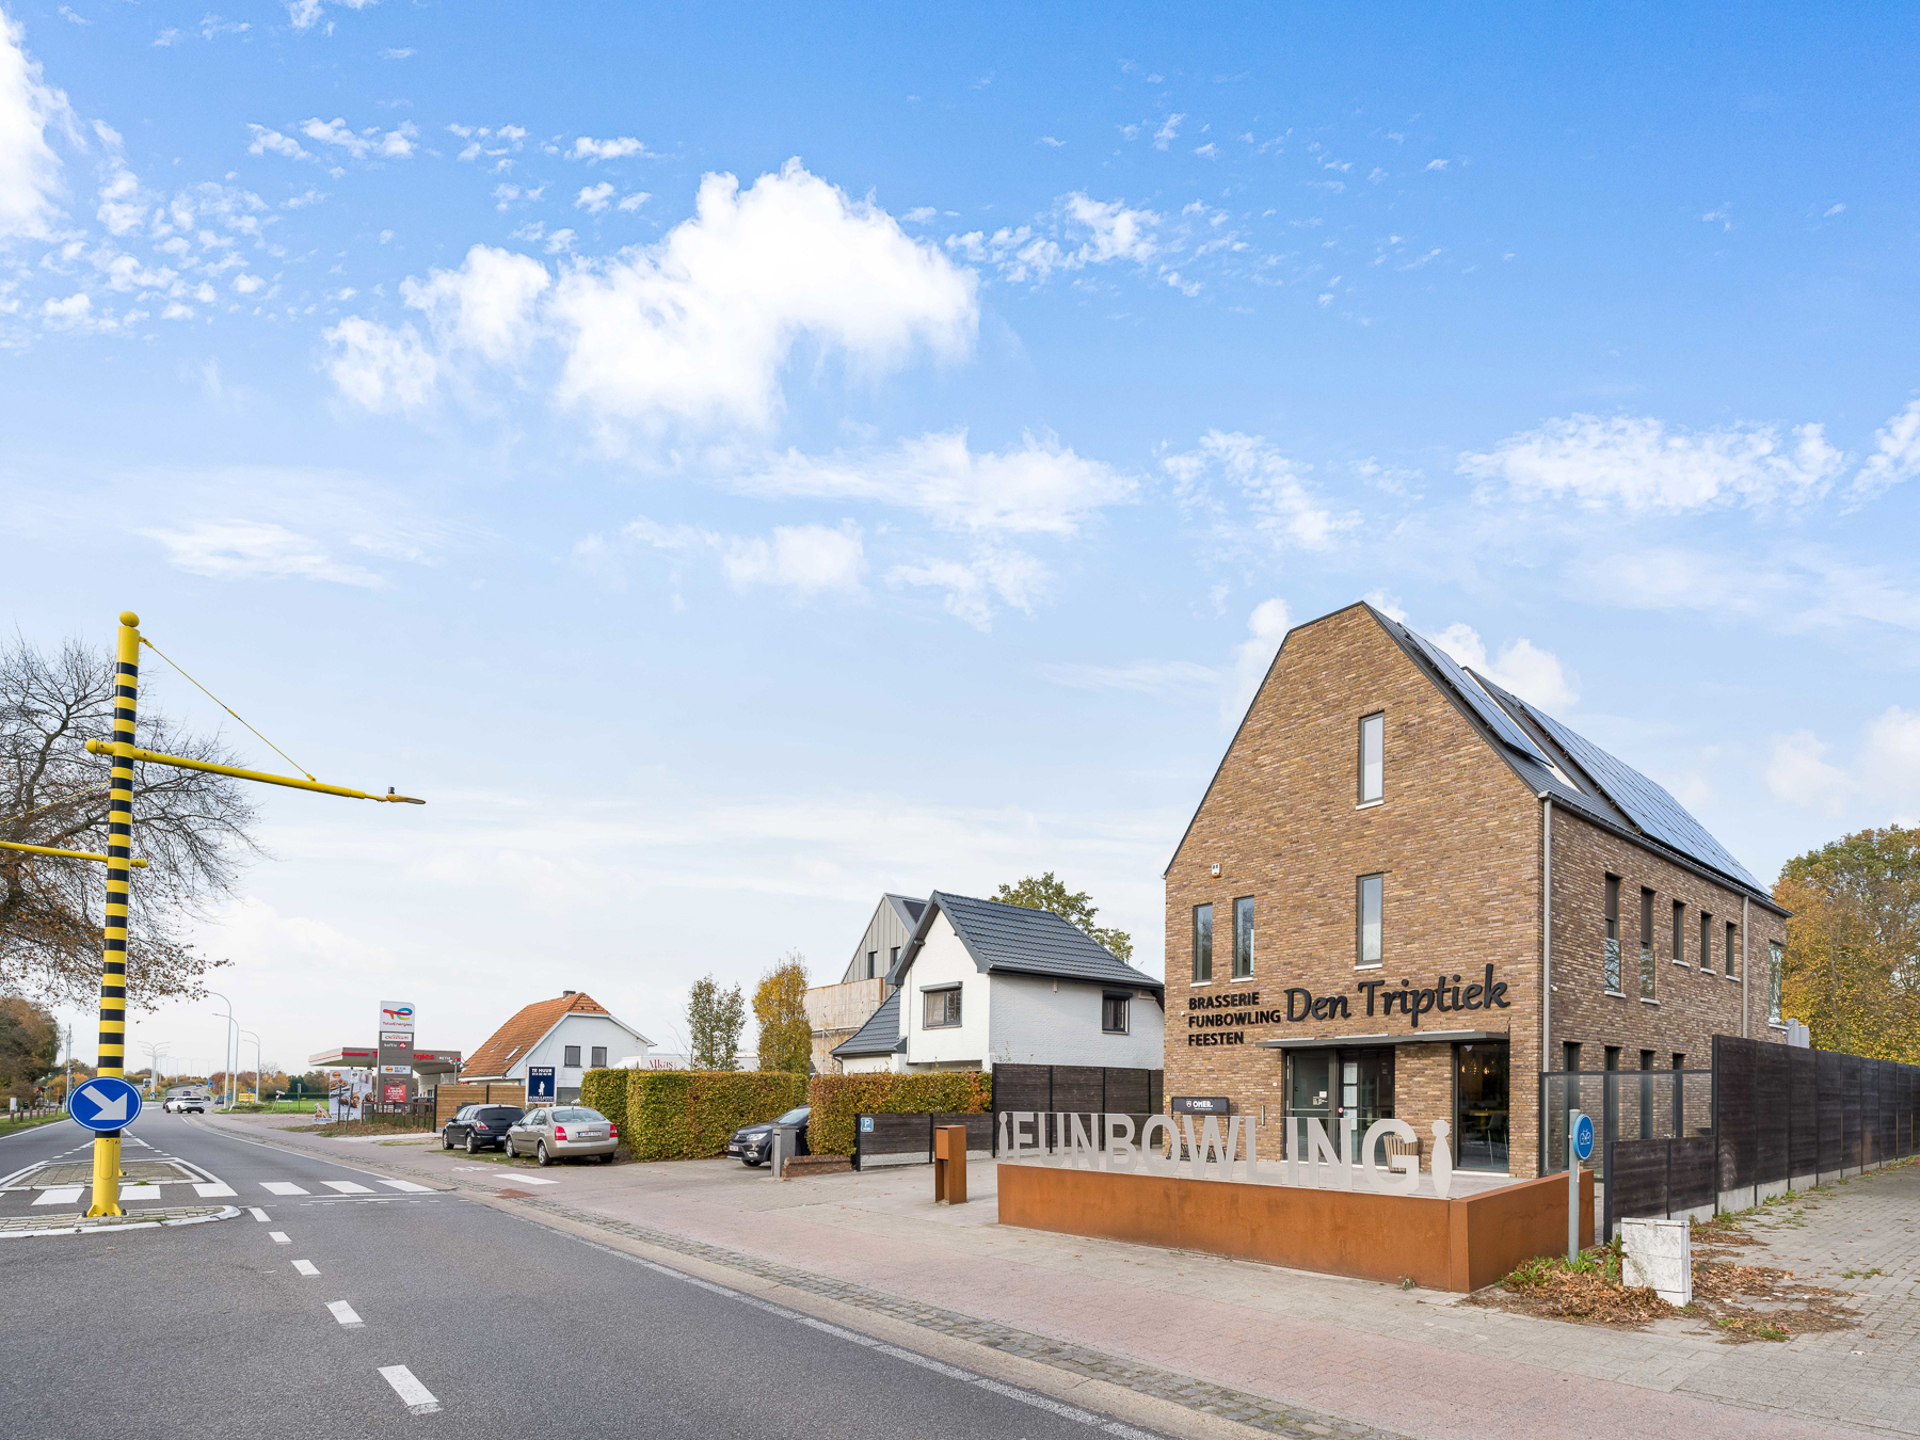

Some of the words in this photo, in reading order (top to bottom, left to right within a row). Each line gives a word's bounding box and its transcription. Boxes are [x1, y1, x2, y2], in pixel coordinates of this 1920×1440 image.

[1188, 991, 1260, 1011] BRASSERIE
[1283, 987, 1351, 1022] Den
[1357, 963, 1511, 1028] Triptiek
[1188, 1009, 1281, 1028] FUNBOWLING
[1188, 1031, 1244, 1047] FEESTEN
[1013, 1111, 1420, 1195] FUNBOWLING
